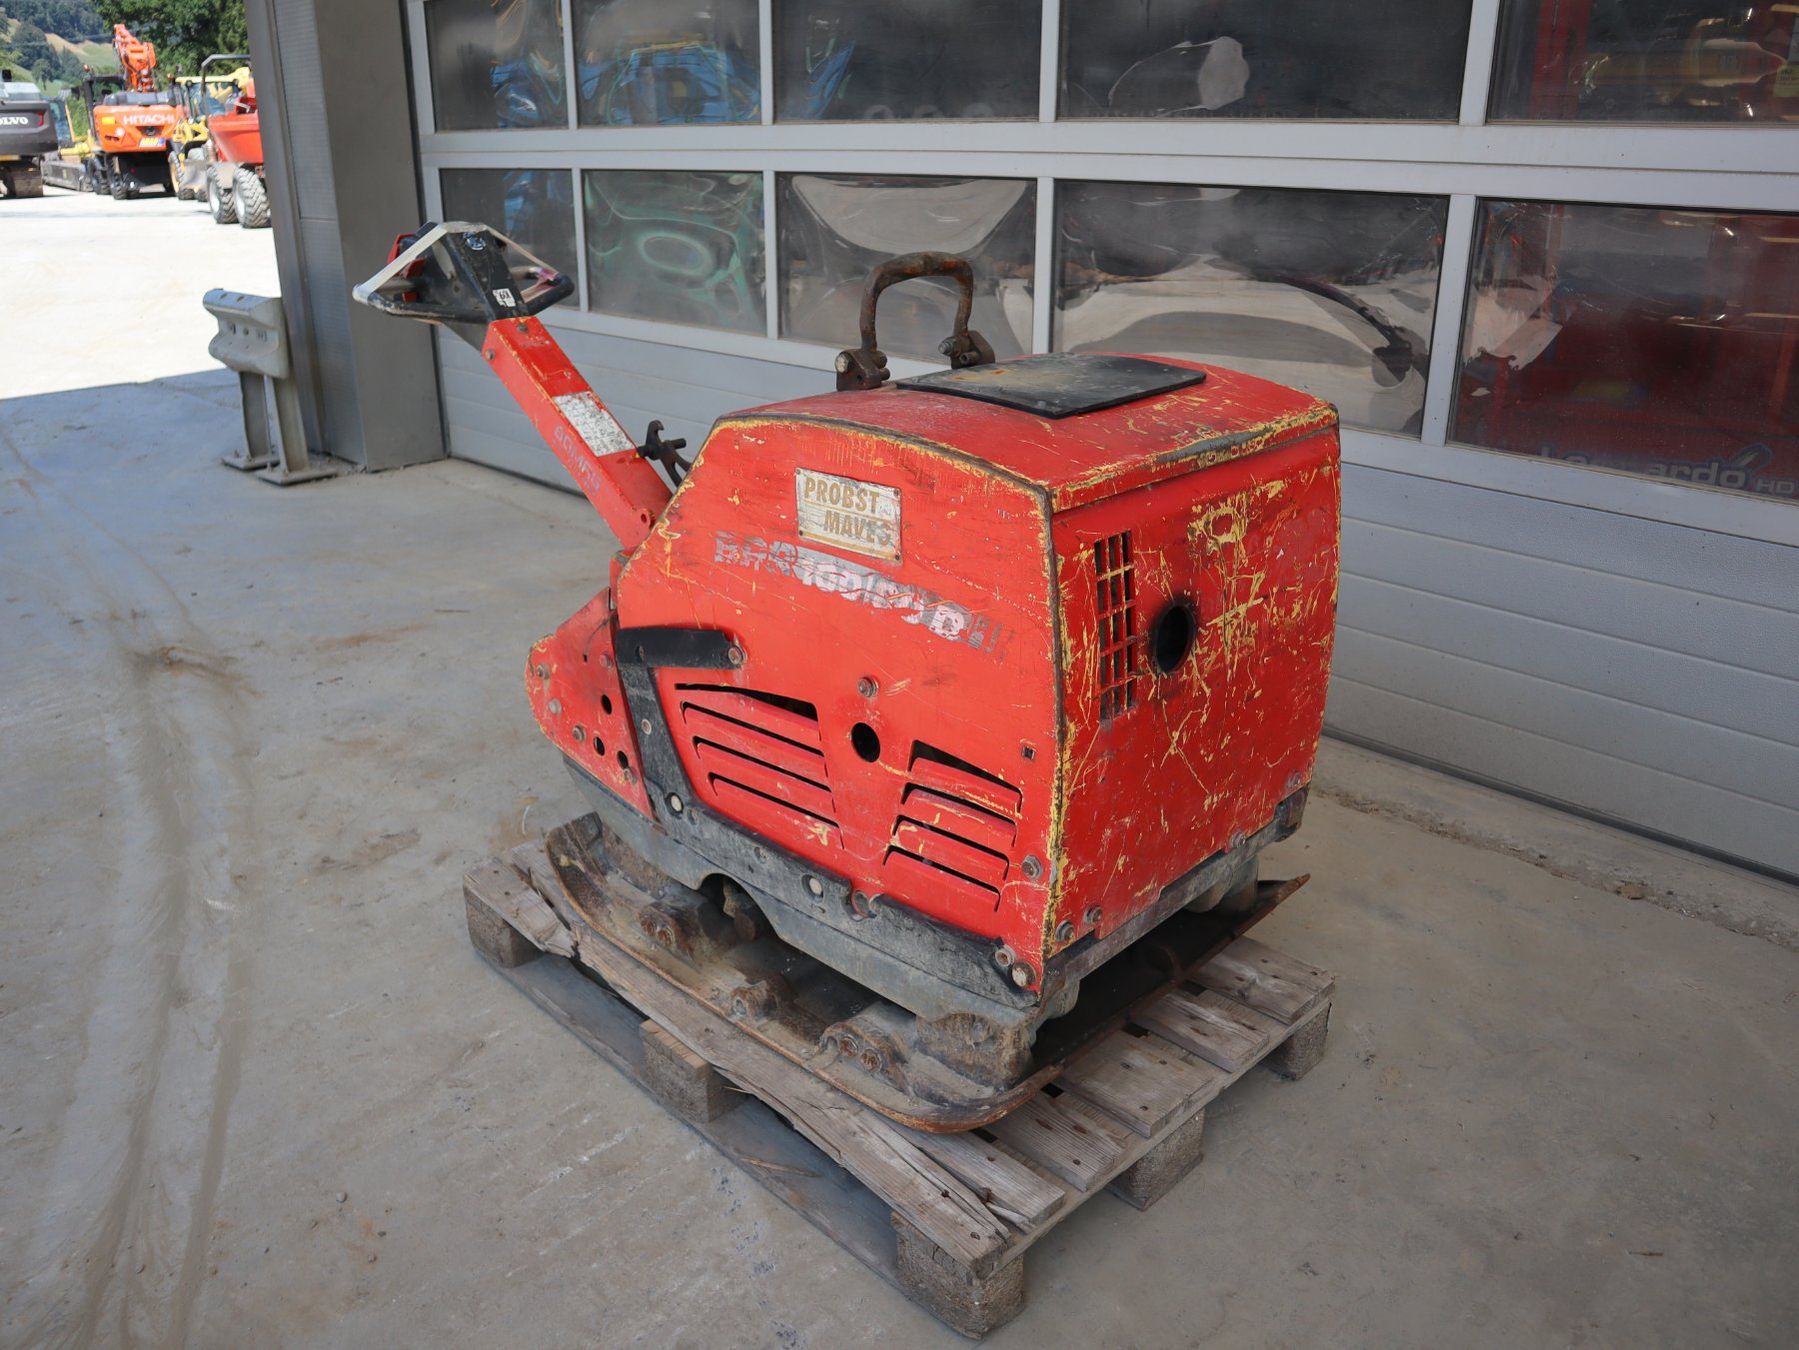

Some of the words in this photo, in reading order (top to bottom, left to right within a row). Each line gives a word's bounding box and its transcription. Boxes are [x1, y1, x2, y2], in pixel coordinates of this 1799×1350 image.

[123, 114, 175, 125] HITACHI
[803, 476, 881, 515] PROBST
[822, 509, 893, 548] MAVES
